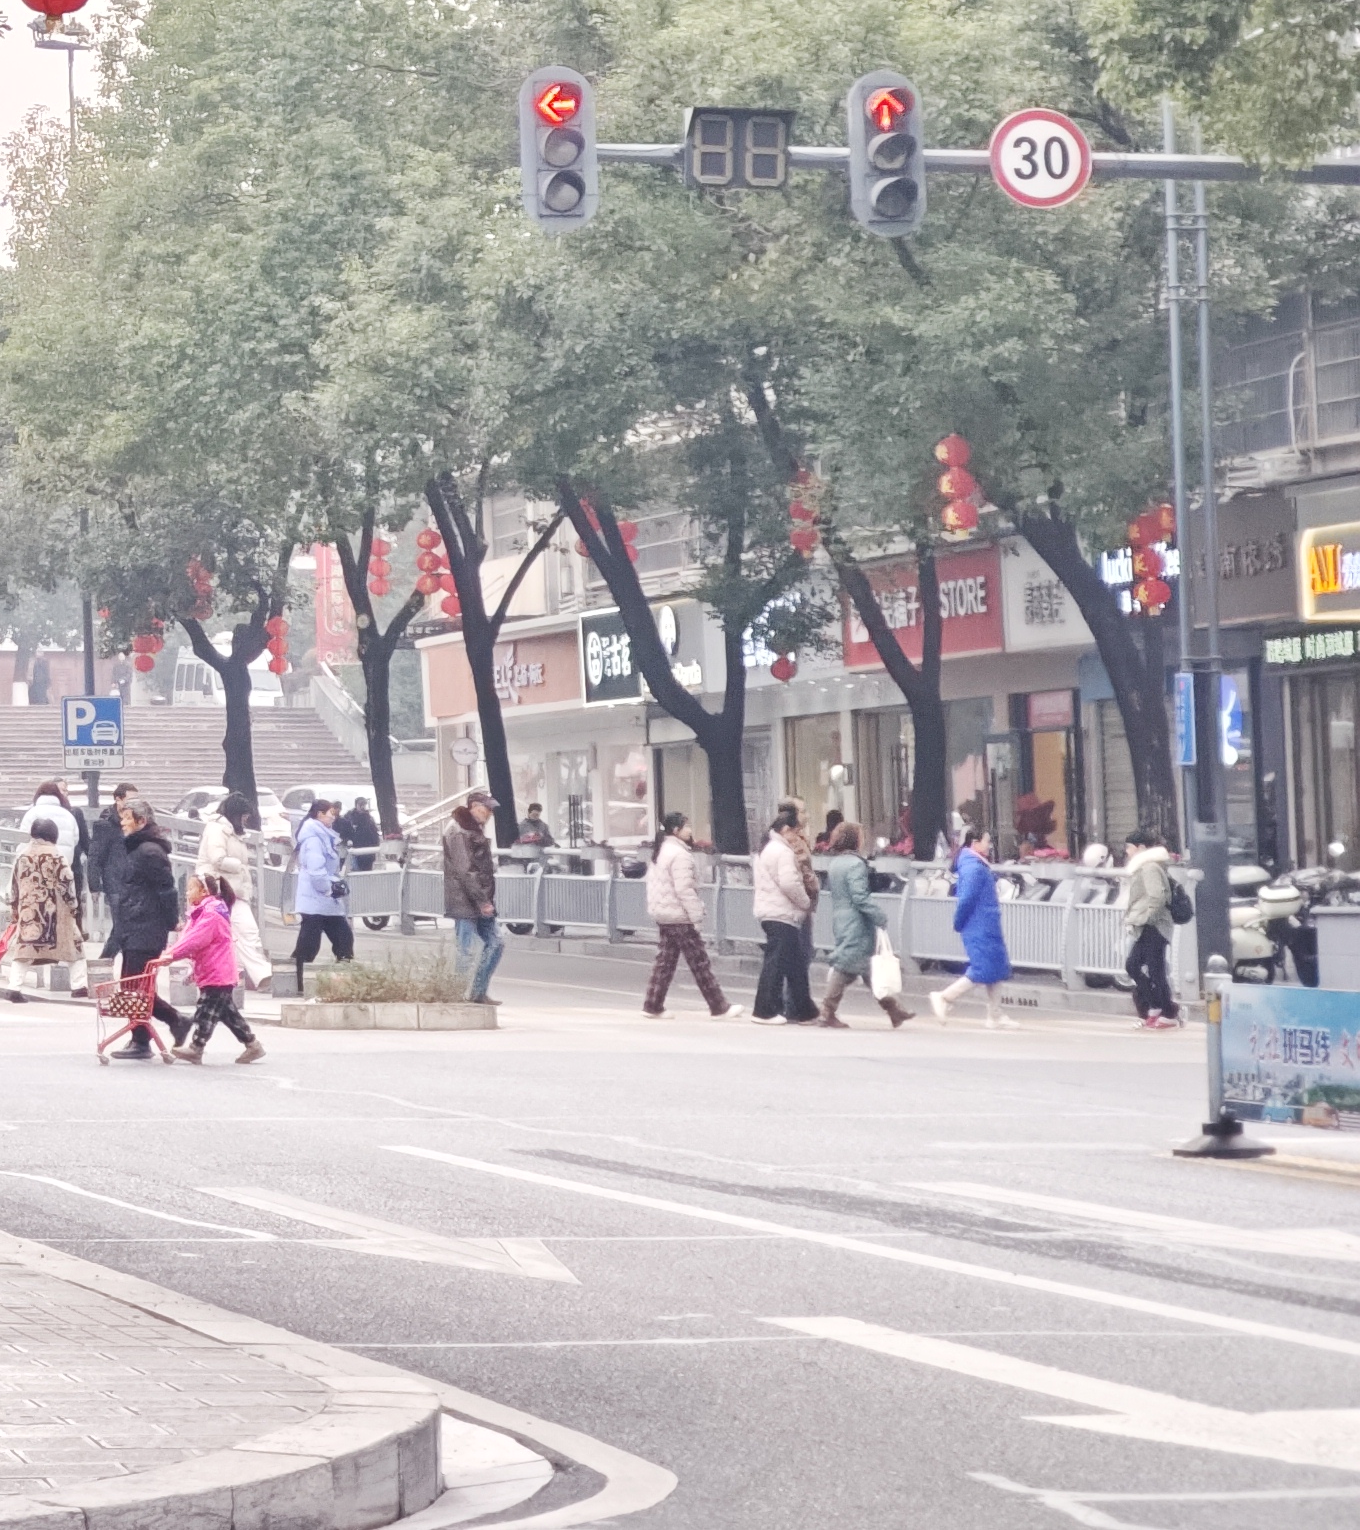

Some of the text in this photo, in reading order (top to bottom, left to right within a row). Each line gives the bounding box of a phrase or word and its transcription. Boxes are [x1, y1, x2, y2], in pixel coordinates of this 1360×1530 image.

[1013, 136, 1070, 180] 30
[939, 576, 988, 619] STORE
[67, 700, 96, 741] P
